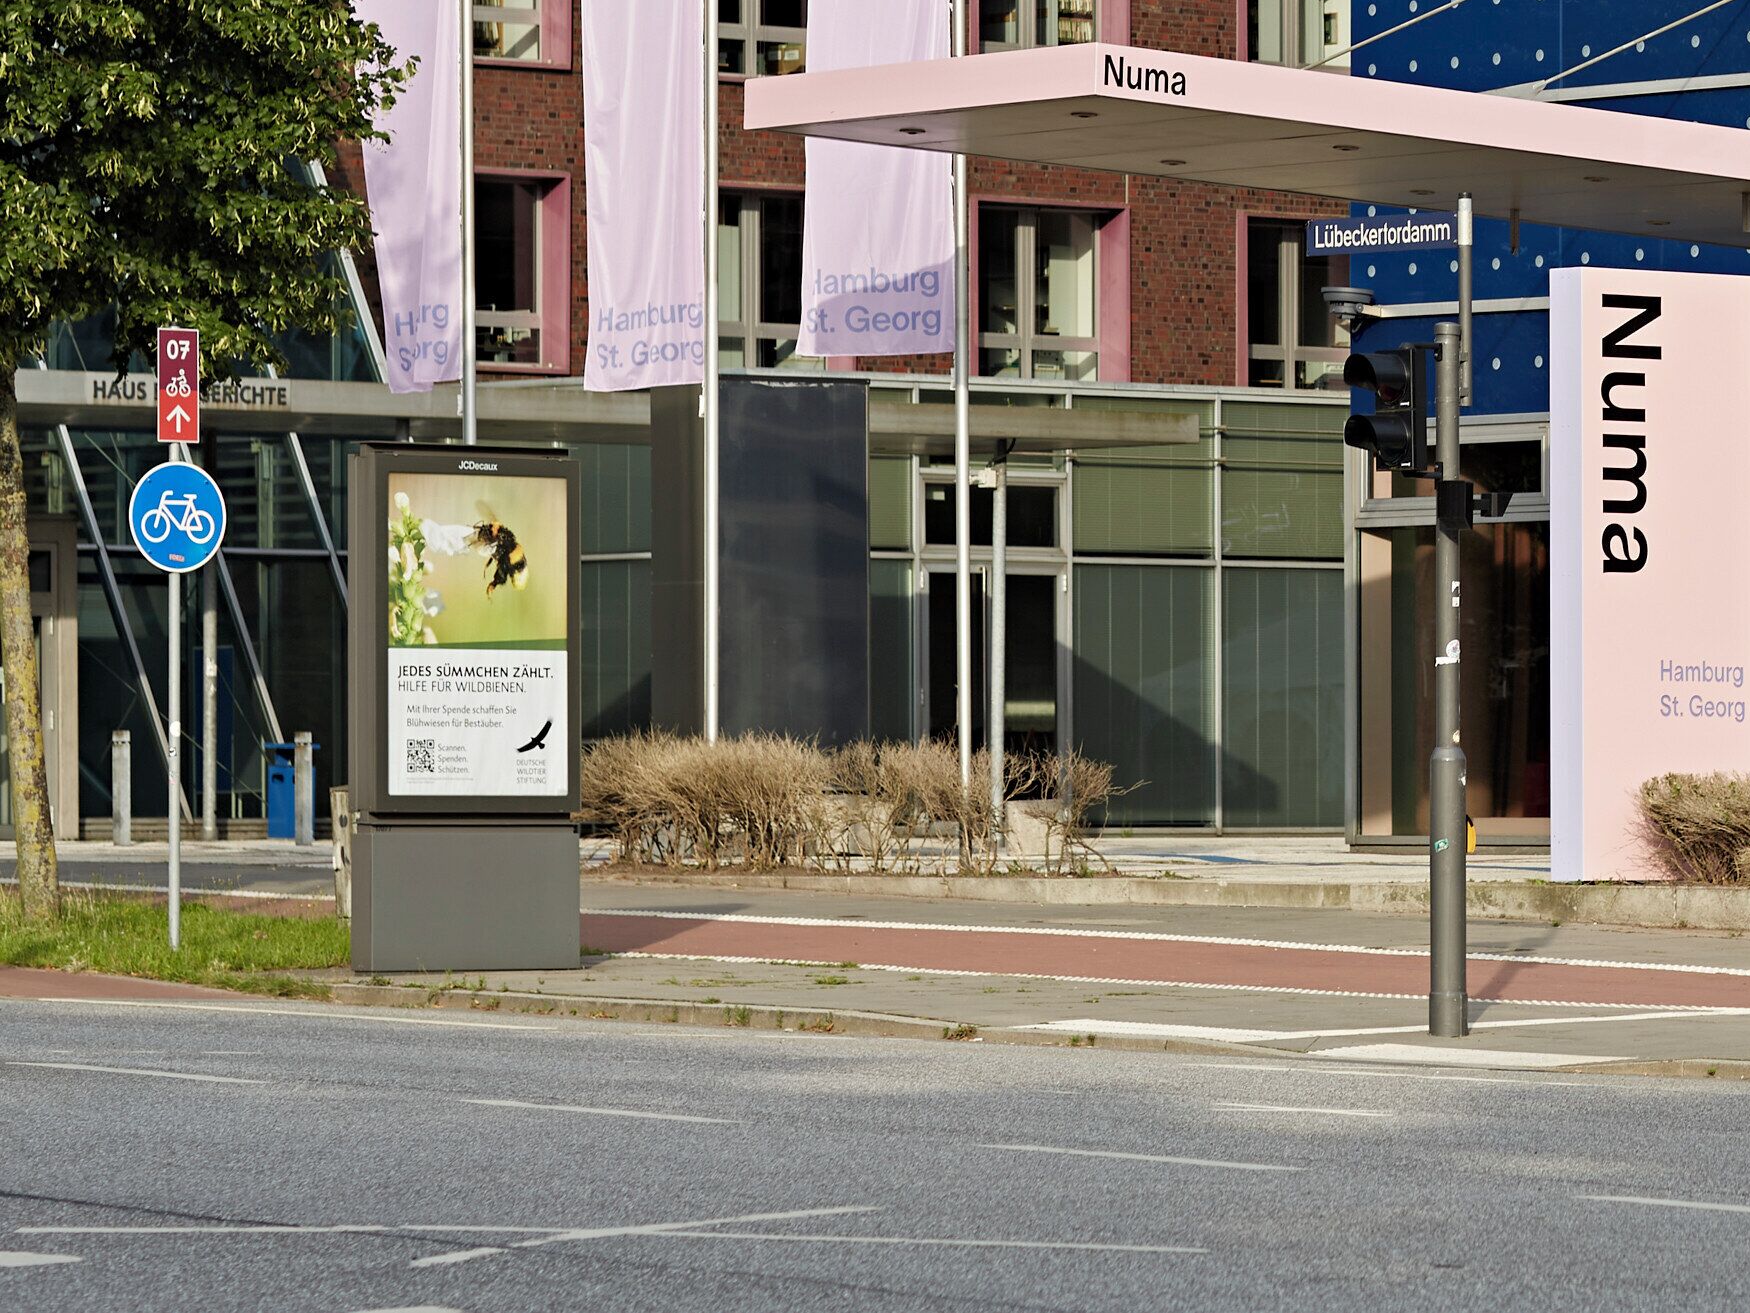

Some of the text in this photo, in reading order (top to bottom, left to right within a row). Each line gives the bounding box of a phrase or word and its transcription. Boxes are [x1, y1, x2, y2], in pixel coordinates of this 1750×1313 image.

[1104, 54, 1187, 96] Numa
[1314, 219, 1451, 249] Lübeckertordamm
[597, 301, 704, 333] Hamburg
[807, 305, 941, 336] St. Georg
[166, 339, 190, 360] 07
[597, 338, 704, 369] St. Georg
[93, 379, 147, 401] HAUS
[1600, 293, 1663, 574] Numa
[458, 460, 498, 471] JCDecaux
[398, 663, 554, 679] JEDES SÜMMCHEN ZÄHLT.
[1660, 659, 1745, 688] Hamburg
[398, 678, 527, 693] HILFE FÜR WILDBIENEN.
[406, 705, 517, 716] Mit Ihrer Spende schaffen Sie
[1660, 694, 1746, 722] St. Georg
[406, 717, 504, 728] Blühwiesen für Bestäuber.
[437, 744, 466, 752] Scannen.
[437, 755, 468, 763] Spenden.
[516, 759, 546, 767] DEUTSCHE
